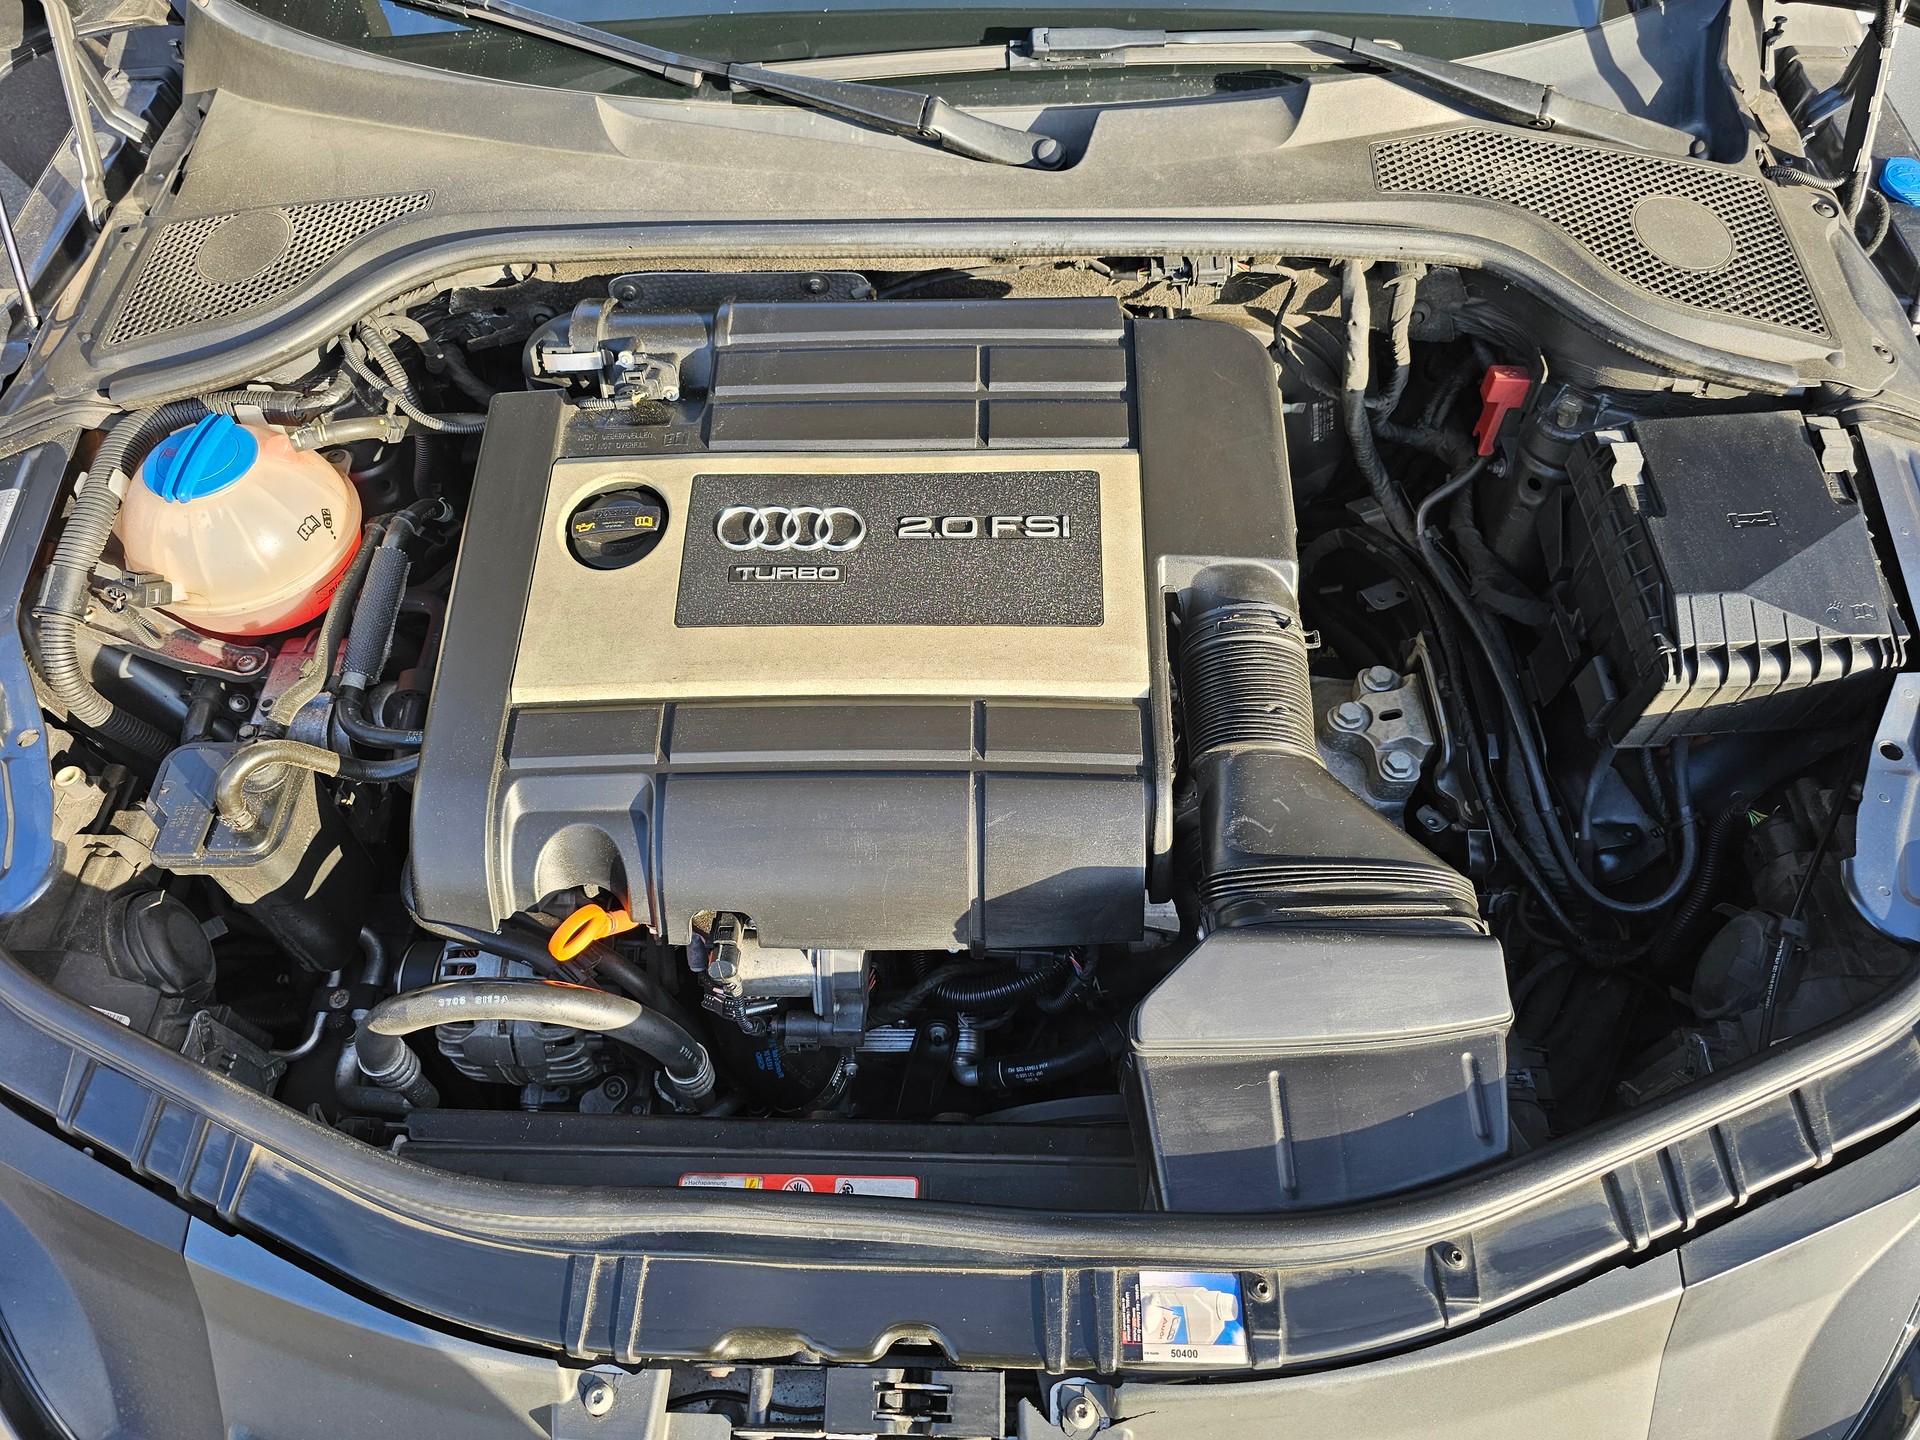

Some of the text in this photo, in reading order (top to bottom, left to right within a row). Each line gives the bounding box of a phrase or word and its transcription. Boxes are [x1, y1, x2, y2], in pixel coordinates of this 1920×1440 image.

[897, 515, 1071, 539] 2.0 FSI
[735, 566, 840, 582] TURBO
[688, 1179, 728, 1187] Hochspannung
[1170, 1348, 1199, 1359] 50400
